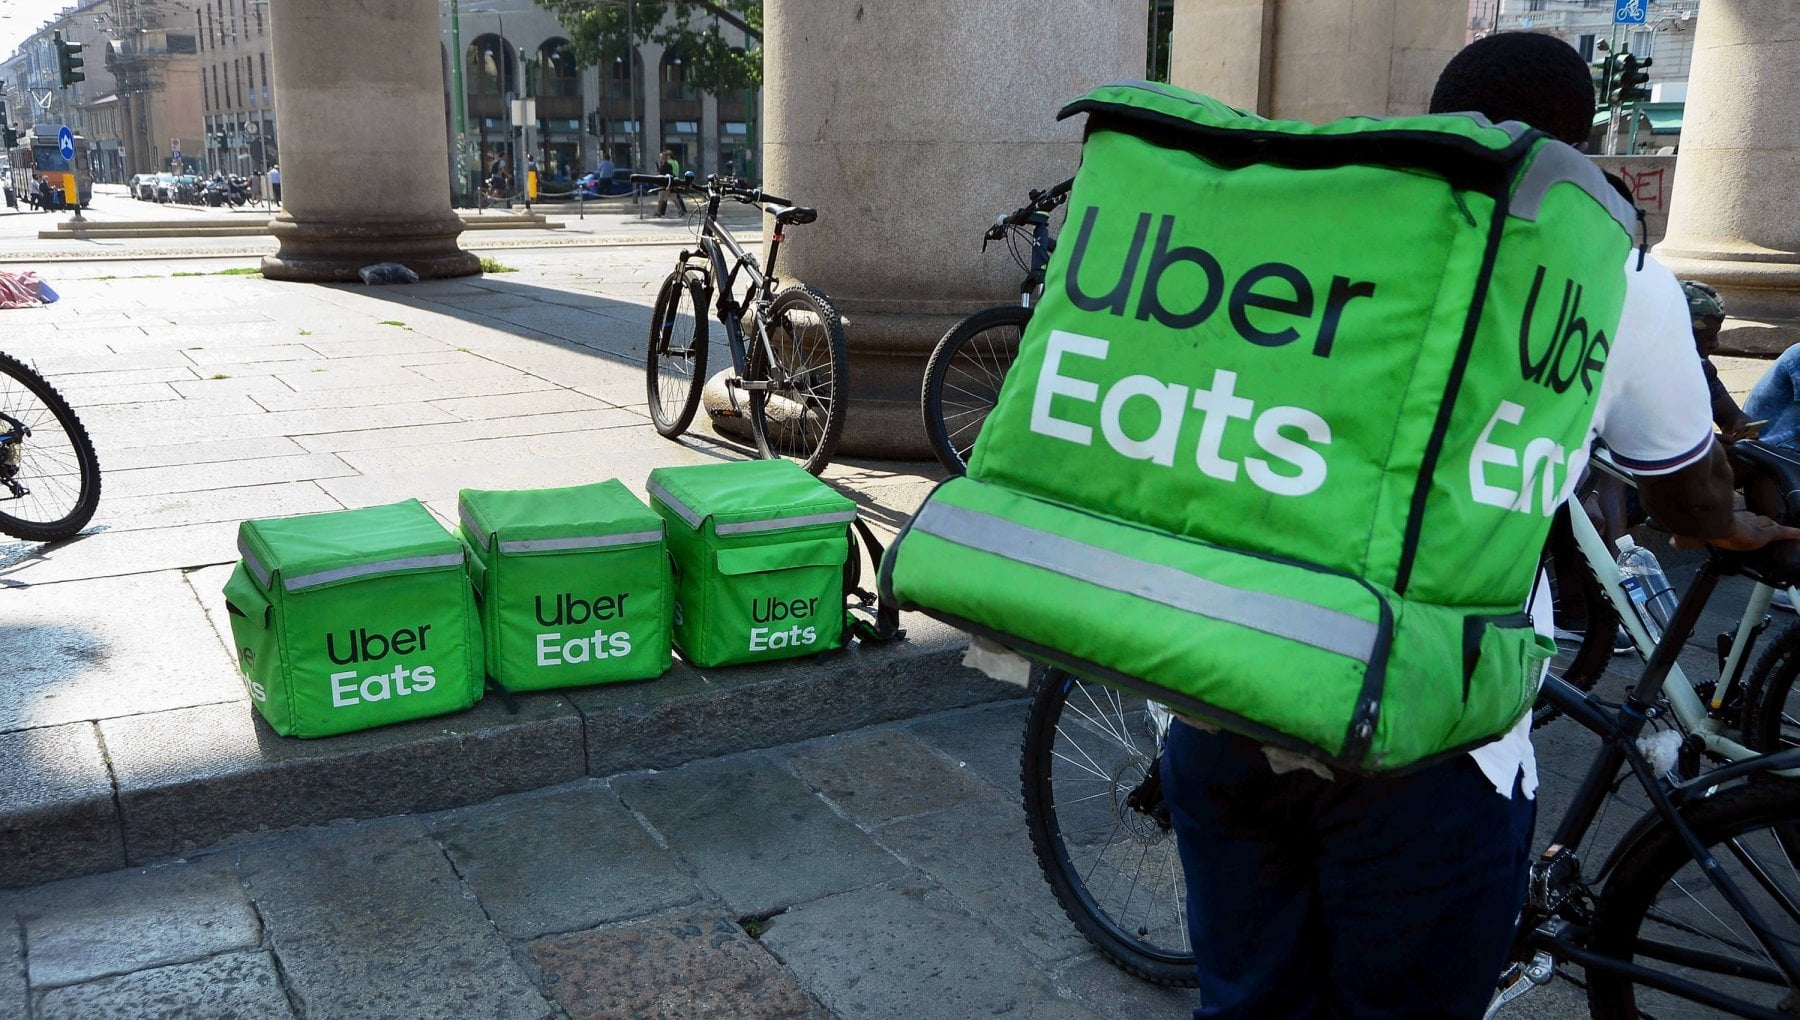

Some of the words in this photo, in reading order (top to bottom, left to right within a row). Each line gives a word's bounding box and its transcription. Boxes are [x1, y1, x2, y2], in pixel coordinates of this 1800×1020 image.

[1064, 205, 1376, 359] Uber
[1518, 264, 1610, 397] Ube
[1029, 329, 1332, 497] Eats
[535, 592, 629, 627] Uber
[752, 596, 818, 624] Uber
[326, 624, 431, 666] Uber
[536, 629, 632, 667] Eats
[749, 624, 817, 652] Eats
[330, 664, 436, 708] Eats
